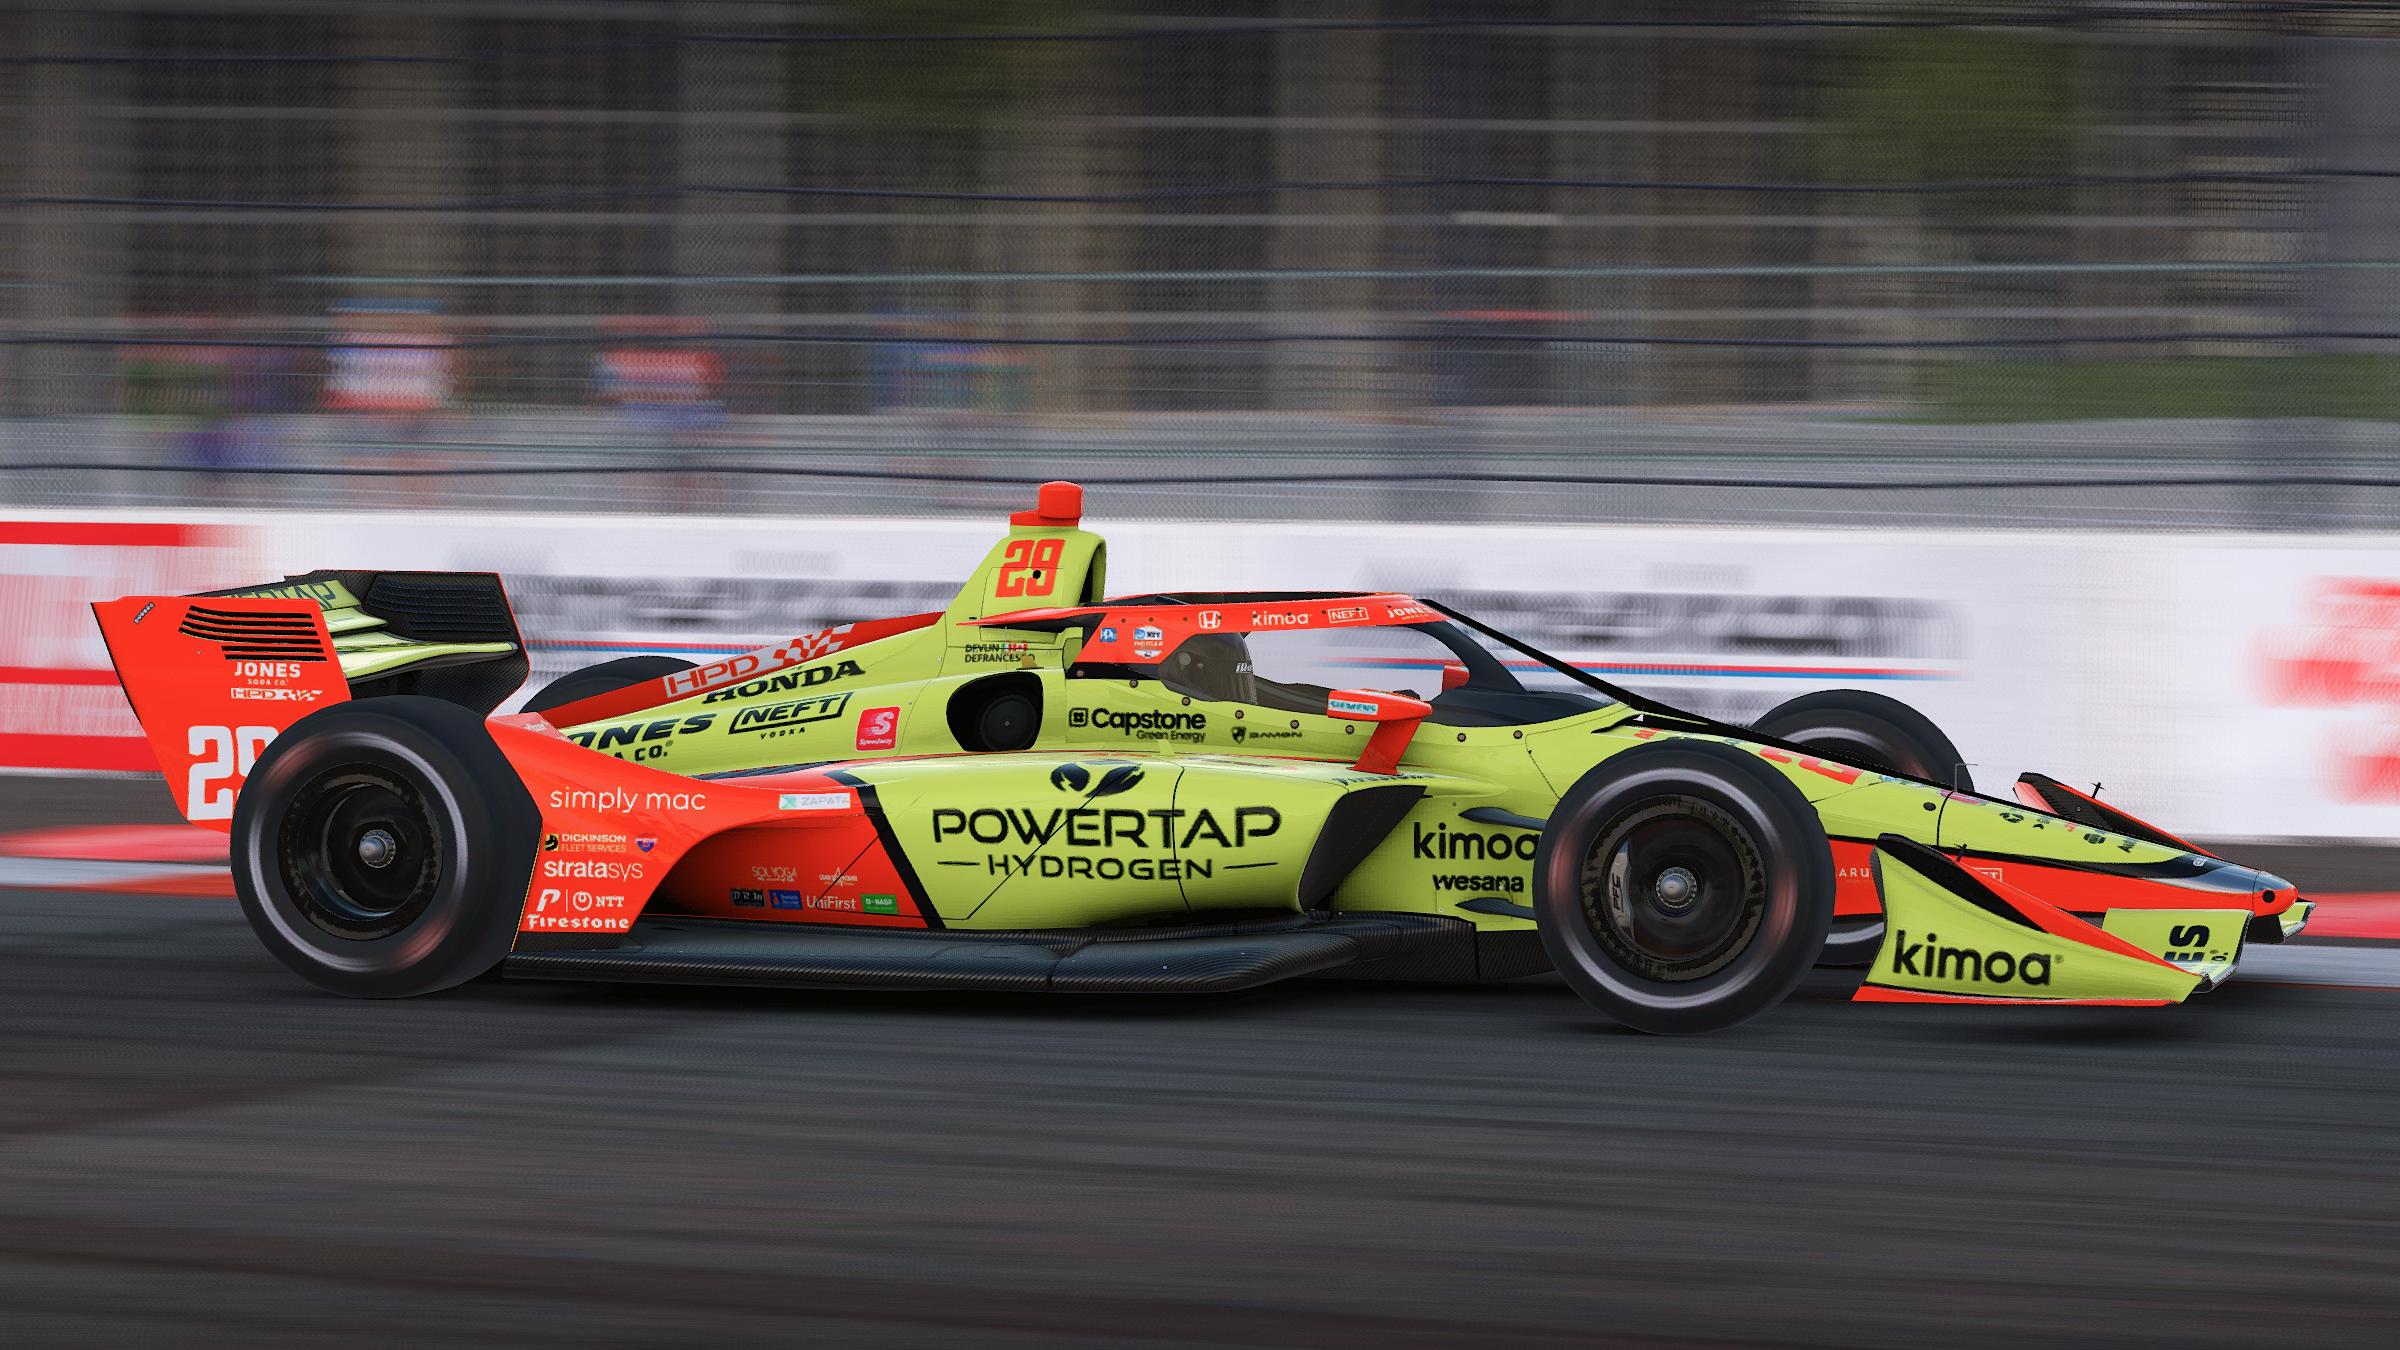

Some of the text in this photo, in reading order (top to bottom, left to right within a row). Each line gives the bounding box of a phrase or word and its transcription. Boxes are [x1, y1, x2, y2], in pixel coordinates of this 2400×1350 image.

[995, 539, 1065, 598] 29
[1252, 611, 1309, 626] kimoa
[1332, 609, 1366, 620] NEFT
[965, 643, 1000, 653] DEVLIN
[965, 653, 1035, 663] DEFRANCESO
[234, 662, 301, 678] JONES
[668, 655, 759, 697] HPD
[702, 660, 866, 704] HONDA
[232, 689, 274, 699] HPD
[741, 697, 834, 724] NEFT
[1330, 700, 1377, 712] SIEMENS
[567, 713, 717, 750] ONES
[1091, 708, 1206, 741] Capstone
[759, 726, 806, 740] VODKA
[1136, 728, 1206, 744] Green Energy
[859, 737, 893, 747] Speedway
[550, 786, 706, 813] simply mac
[801, 793, 850, 806] ZAPATA
[932, 806, 1282, 849] POWERTAP
[562, 834, 626, 843] DICKINSON
[1413, 822, 1537, 860] kimoa
[562, 844, 626, 852] FLEET SERVICES
[544, 858, 643, 882] stratasys
[988, 853, 1213, 880] HYDROGEN
[1432, 873, 1525, 892] wesana
[596, 895, 625, 907] NTT
[806, 895, 857, 910] UniFirst
[527, 913, 630, 929] Firestone
[1893, 930, 2051, 985] kimoa
